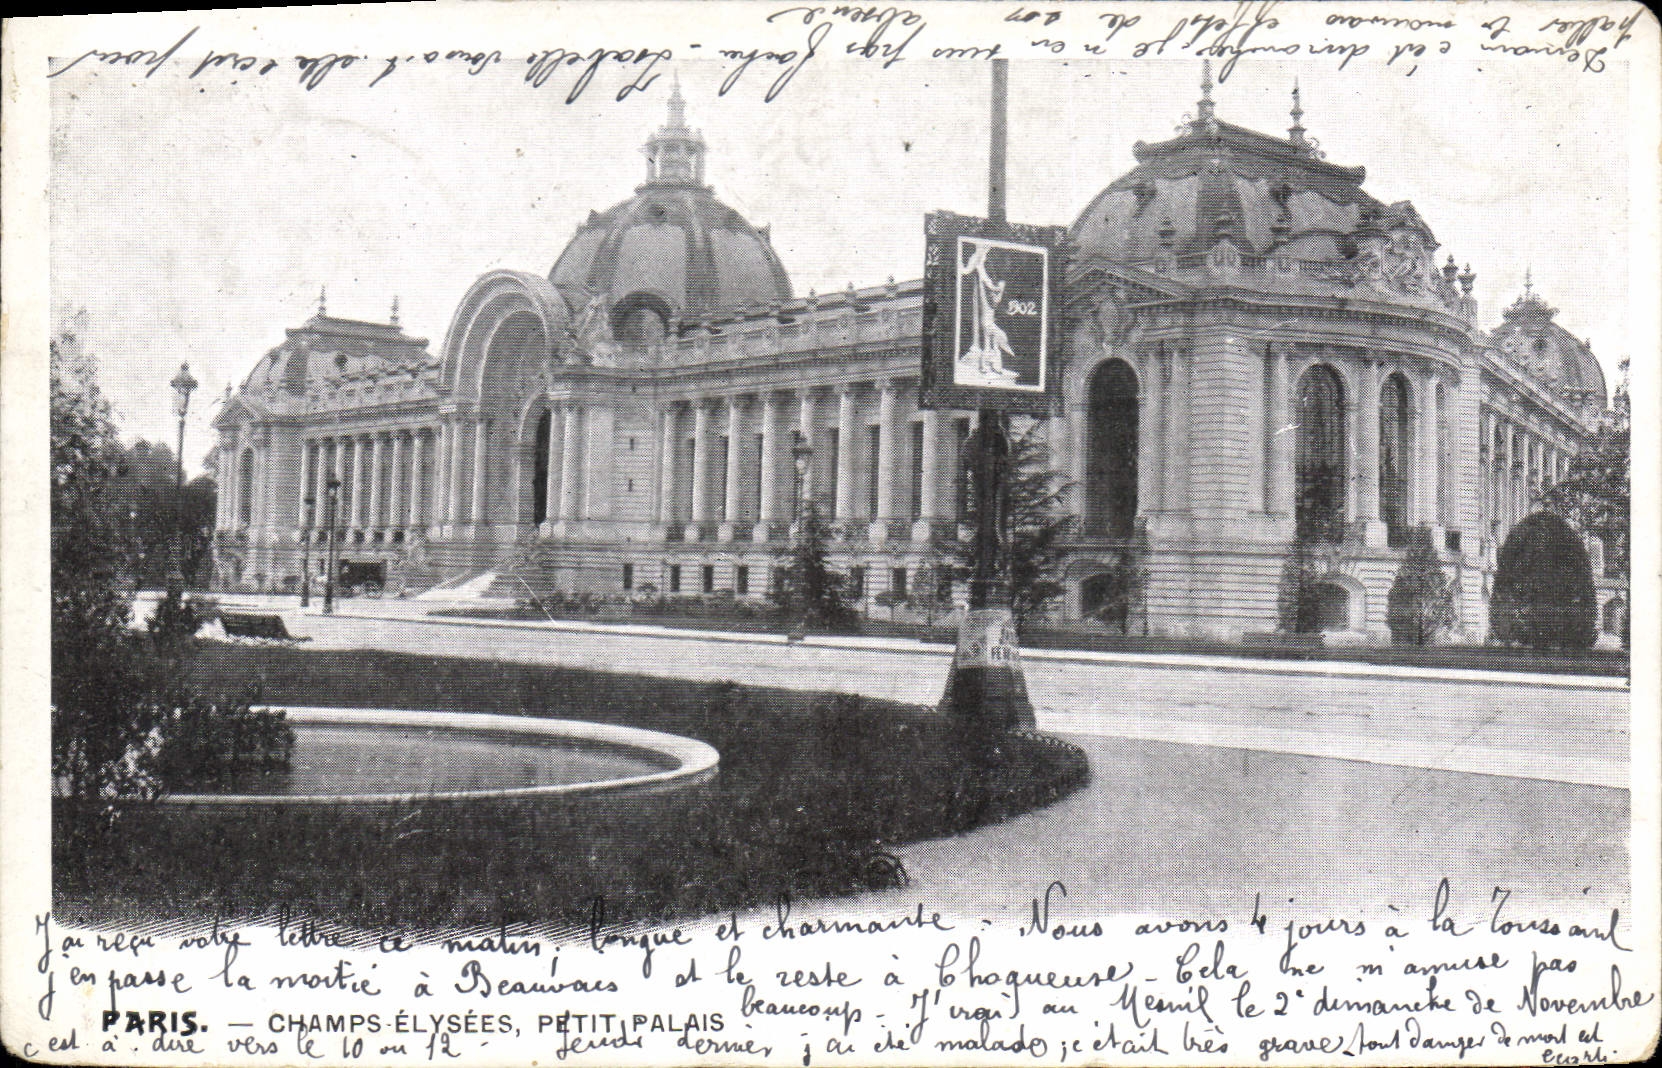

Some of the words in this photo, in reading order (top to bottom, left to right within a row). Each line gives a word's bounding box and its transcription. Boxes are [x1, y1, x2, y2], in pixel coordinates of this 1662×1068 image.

[846, 22, 925, 69] pas
[1099, 13, 1140, 41] de
[526, 47, 672, 105] Isabelle
[179, 912, 252, 950] votre
[277, 902, 352, 948] lettre
[590, 895, 694, 980] longue
[715, 911, 746, 942] et
[763, 893, 956, 941] charmante
[1026, 880, 1104, 941] Nous
[1135, 919, 1229, 936] avons
[1279, 897, 1366, 974] jours
[1385, 903, 1409, 938] à
[1427, 876, 1474, 937] la
[109, 969, 193, 1013] passe
[206, 943, 257, 990] la
[414, 970, 434, 998] à
[454, 959, 619, 998] Beauvais
[675, 957, 703, 988] et
[714, 945, 753, 985] le
[776, 961, 863, 988] reste
[884, 954, 905, 986] à
[1176, 940, 1249, 984] Cela
[1531, 951, 1578, 994] pas
[741, 983, 863, 1036] beaucoup
[1231, 980, 1266, 1018] le
[1313, 975, 1457, 1017] dimanche
[1464, 988, 1503, 1015] de
[1516, 963, 1655, 1017] Novembre
[226, 1036, 279, 1056] vers
[297, 1022, 327, 1059] le
[342, 1036, 364, 1059] 10
[427, 1032, 461, 1061] 12
[1490, 1020, 1512, 1048] de
